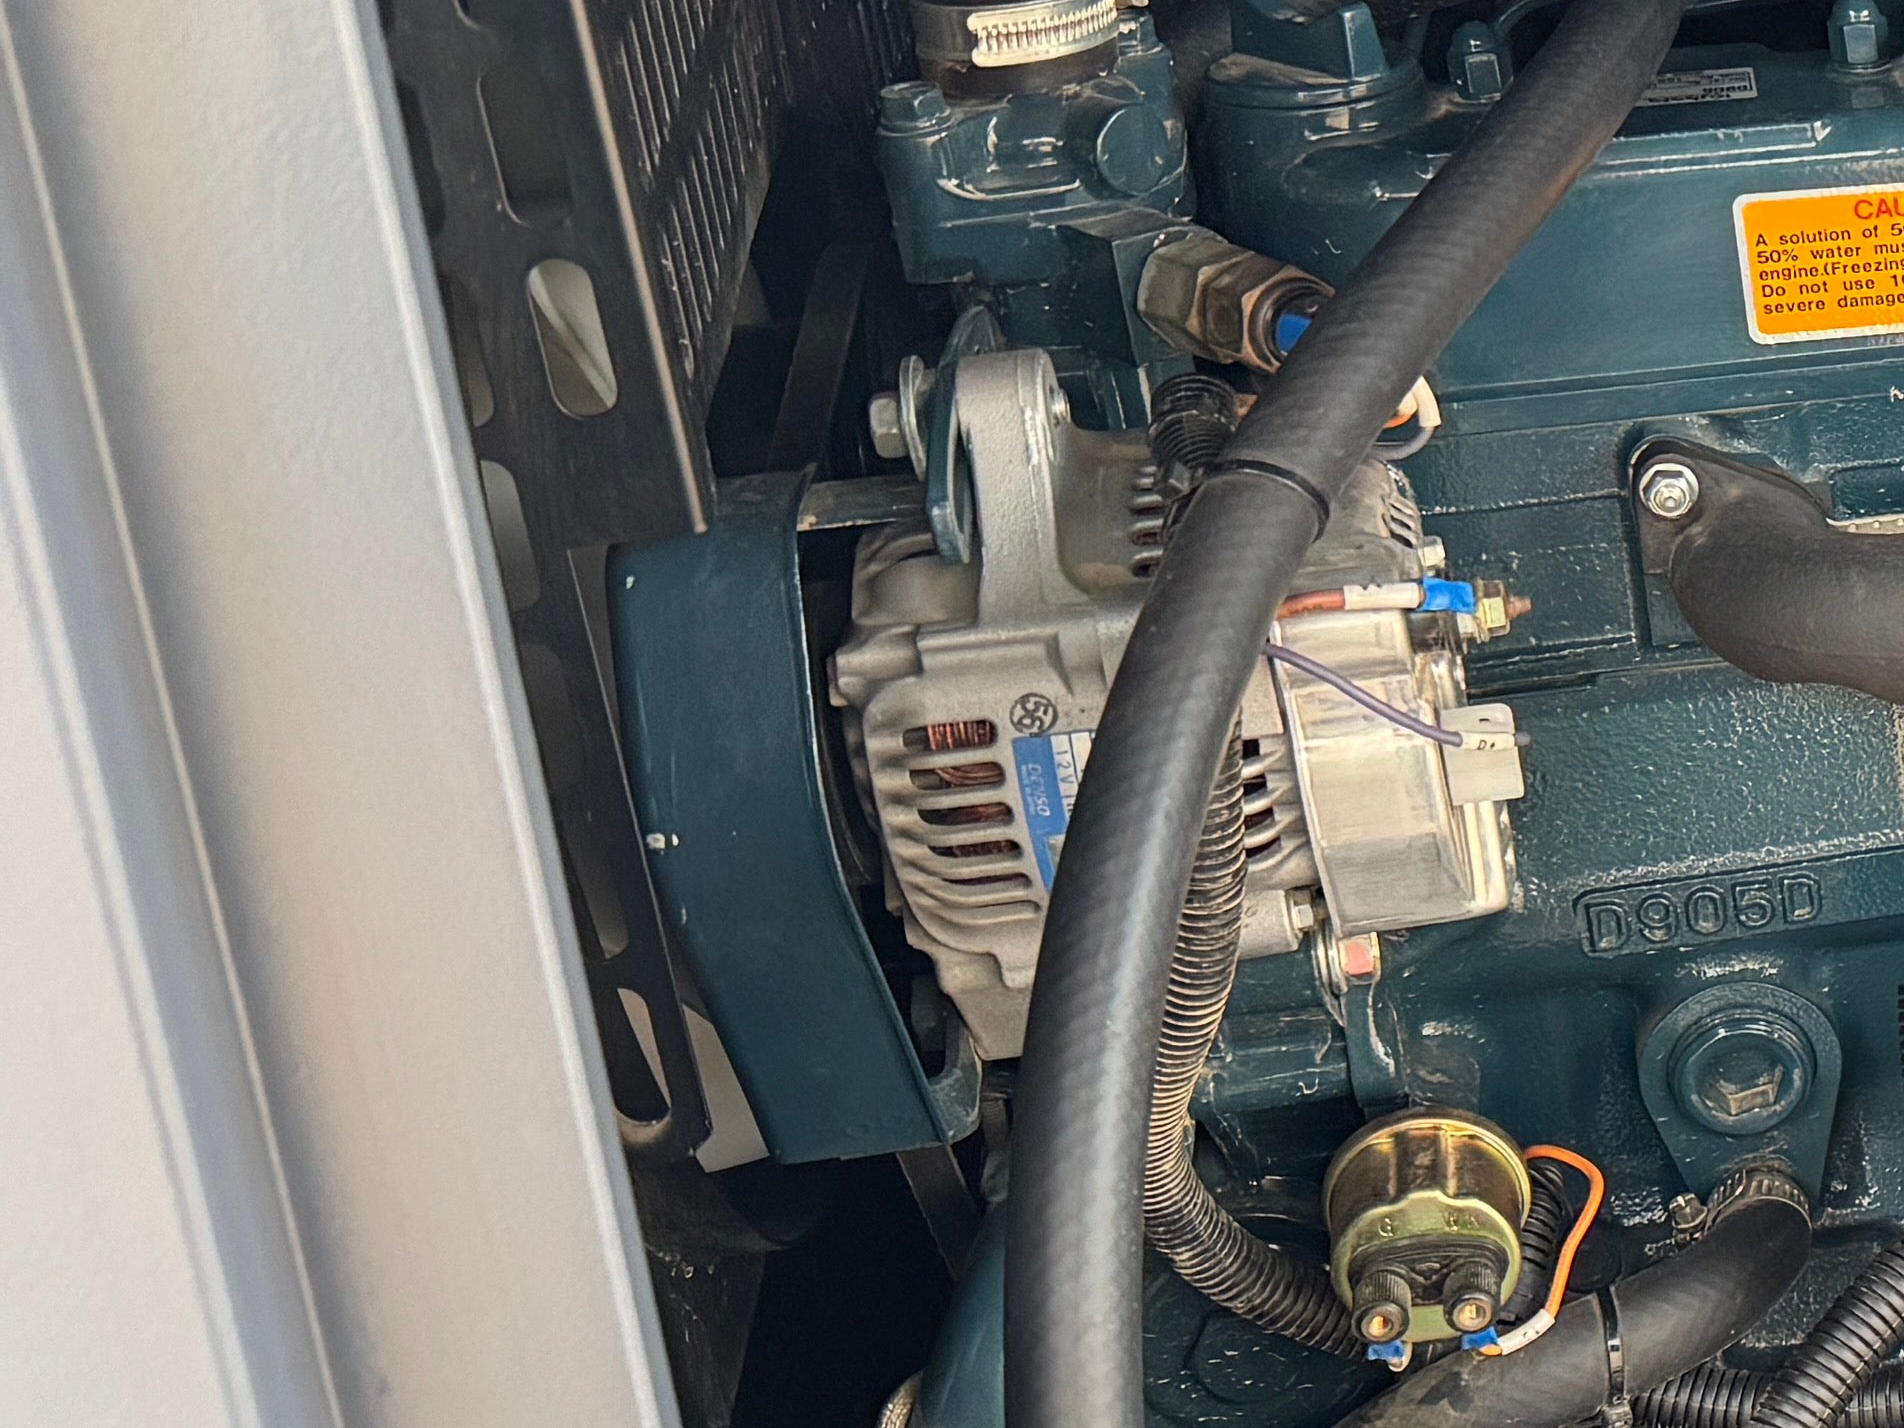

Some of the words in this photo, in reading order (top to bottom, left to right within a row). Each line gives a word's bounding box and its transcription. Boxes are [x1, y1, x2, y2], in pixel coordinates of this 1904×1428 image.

[1755, 234, 1768, 247] A
[1779, 229, 1851, 245] solution
[1862, 225, 1878, 238] of
[1757, 248, 1799, 264] 50%
[1810, 245, 1862, 260] water
[1761, 284, 1786, 298] Do
[1799, 281, 1829, 295] not
[1843, 278, 1875, 291] use
[1763, 299, 1826, 315] severe
[1024, 761, 1053, 818] DENSO
